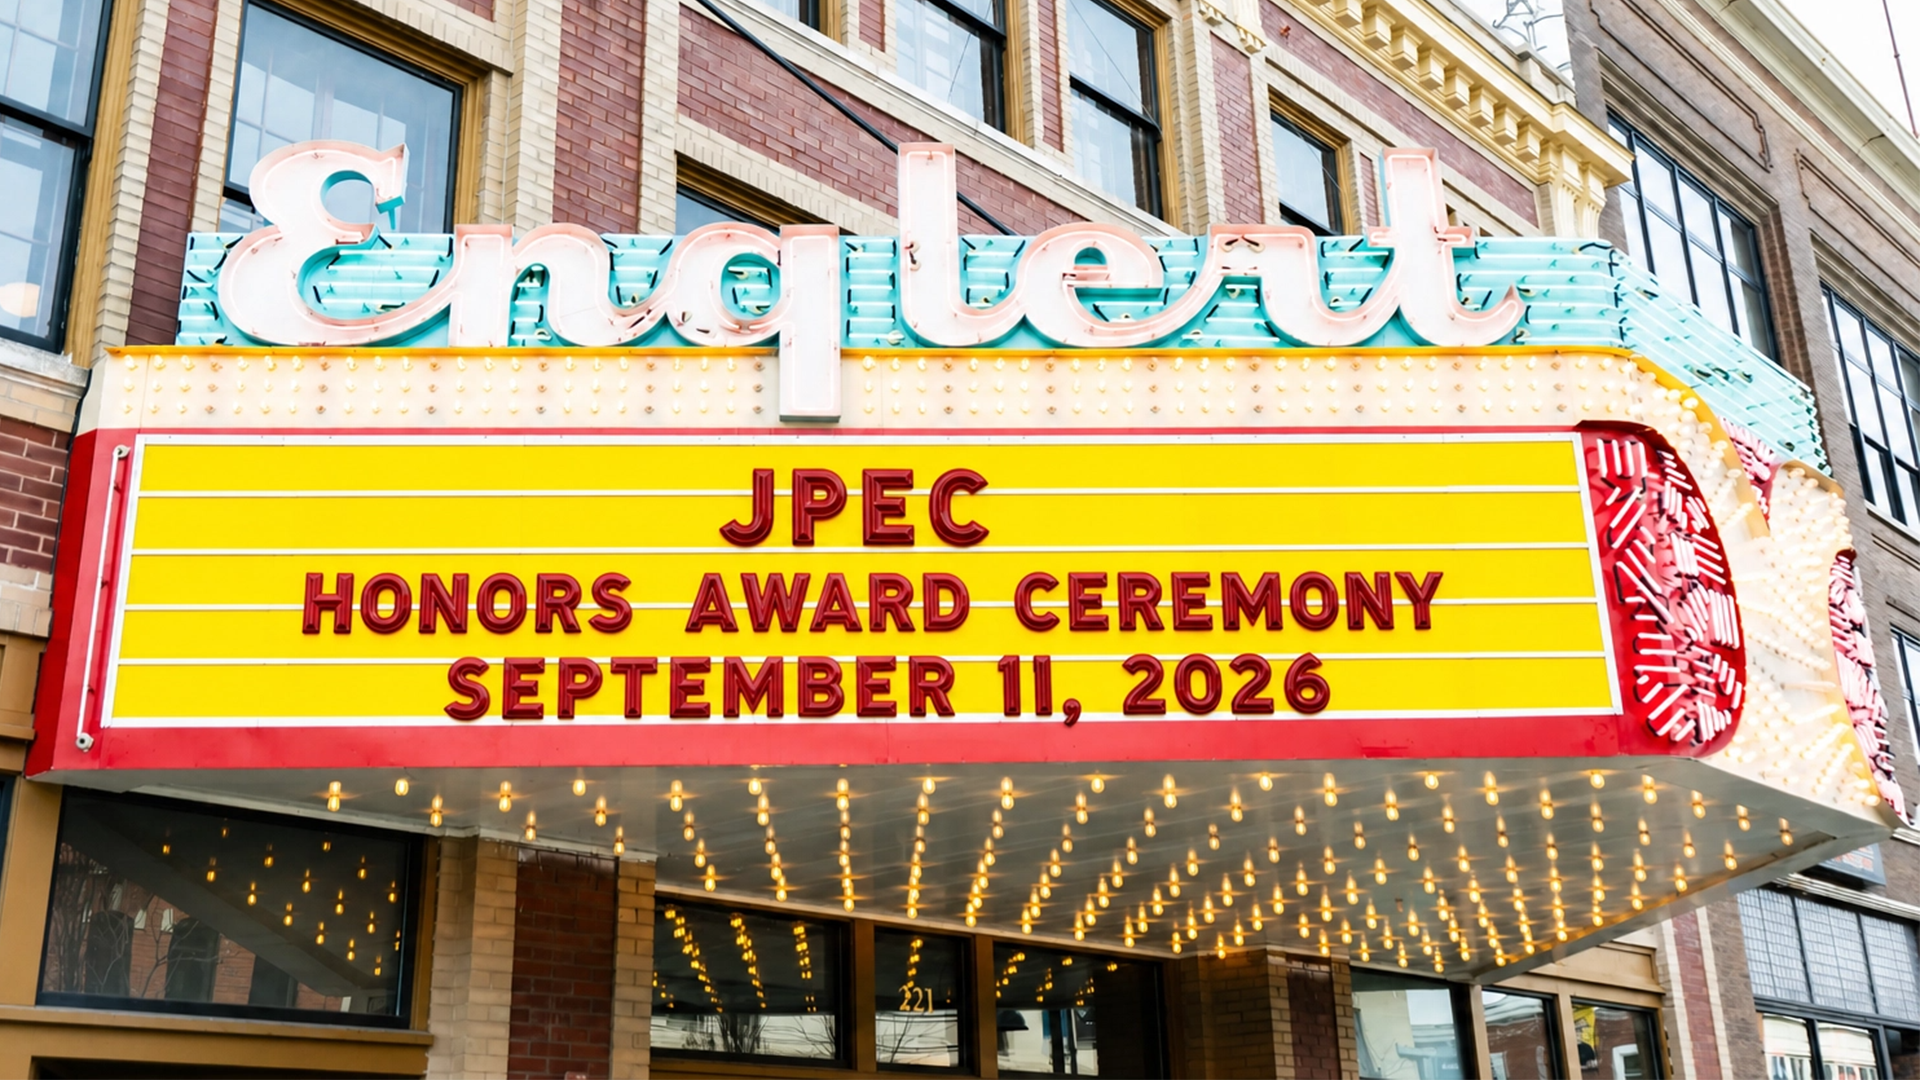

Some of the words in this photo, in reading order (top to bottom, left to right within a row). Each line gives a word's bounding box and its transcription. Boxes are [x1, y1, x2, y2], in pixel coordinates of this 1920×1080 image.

[719, 467, 989, 548] JPEC
[302, 571, 633, 635] HONORS
[685, 571, 971, 634] AWARD
[1013, 571, 1444, 633] CEREMONY
[444, 655, 956, 722] SEPTEMBER
[998, 655, 1082, 729] 11,
[1122, 652, 1331, 717] 2026
[899, 985, 934, 1013] 221
